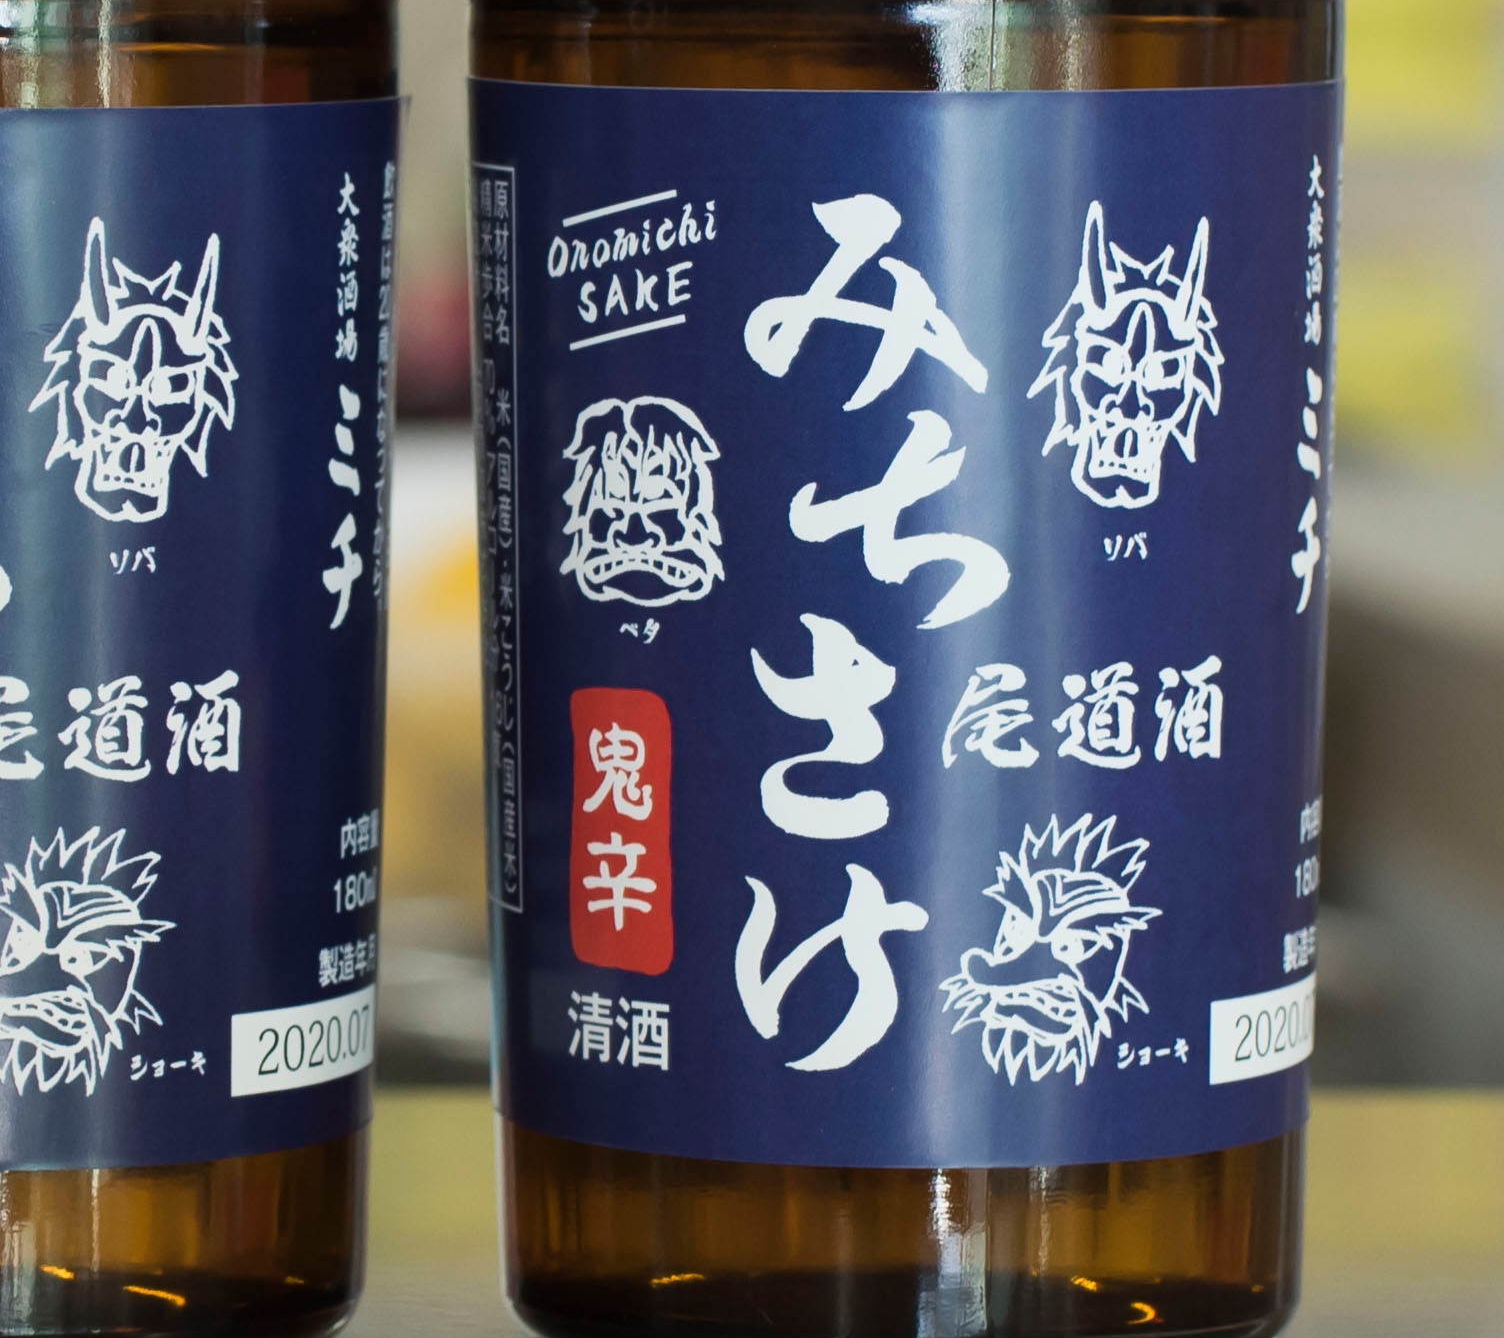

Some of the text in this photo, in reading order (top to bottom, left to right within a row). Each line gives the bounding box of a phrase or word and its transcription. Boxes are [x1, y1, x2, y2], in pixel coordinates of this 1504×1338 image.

[335, 172, 361, 363] 大衆酒場
[547, 199, 718, 279] Onomichi
[1303, 154, 1326, 346] 大衆酒場
[578, 261, 693, 325] SAKE
[735, 192, 1012, 1073] みちさけ
[941, 654, 1223, 769] 尾道酒
[582, 721, 654, 932] 鬼辛
[129, 1050, 208, 1081] ショーキ
[256, 1005, 370, 1078] 2020.07
[568, 989, 671, 1073] 清酒
[1116, 1037, 1190, 1070] ショーキ
